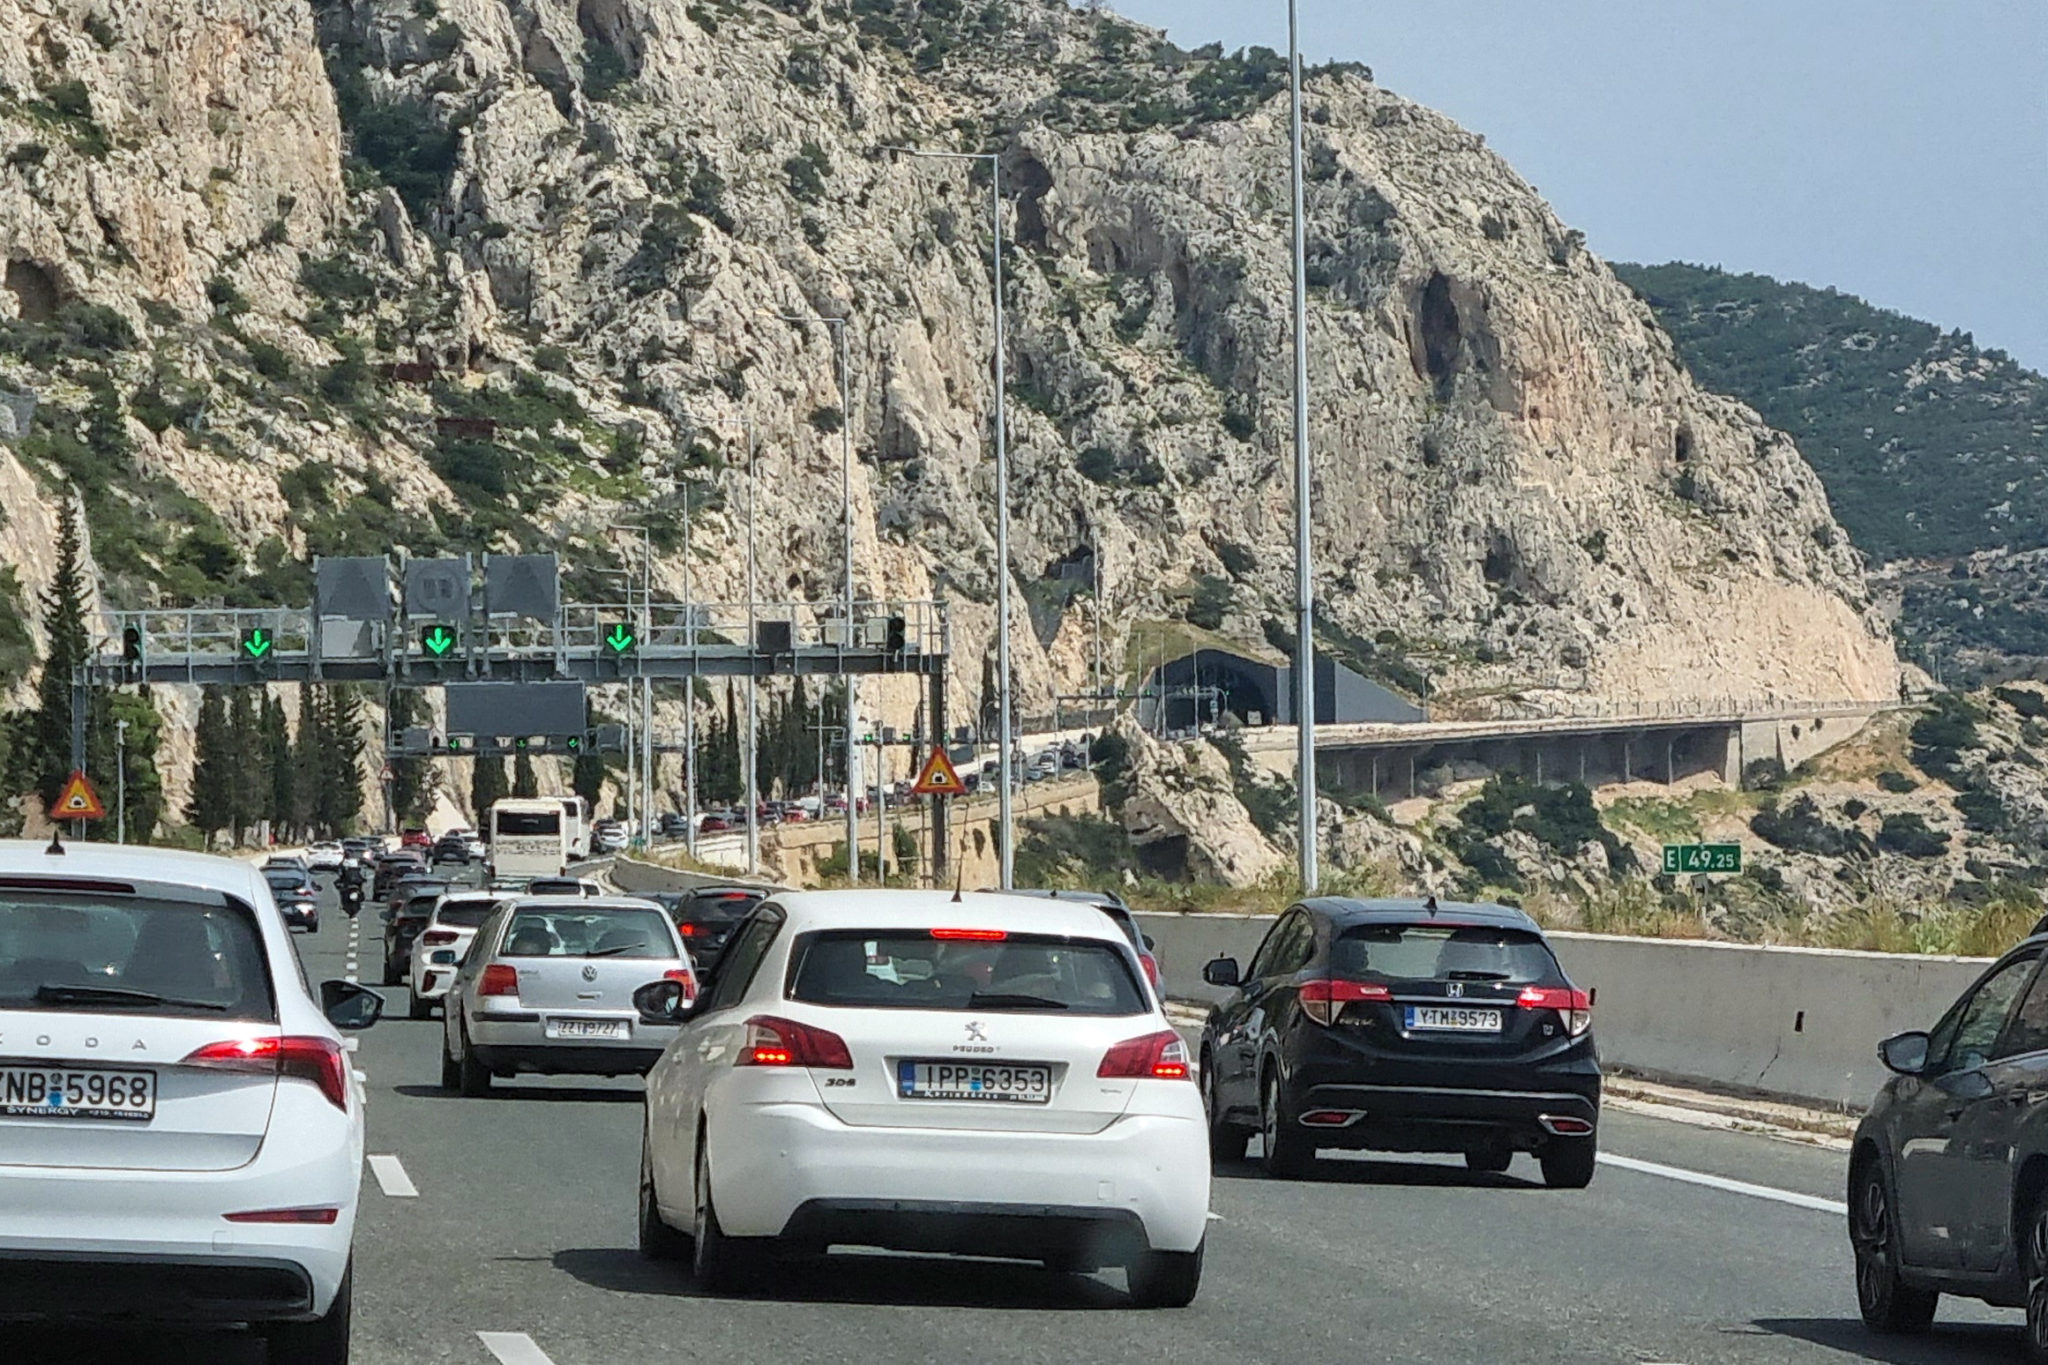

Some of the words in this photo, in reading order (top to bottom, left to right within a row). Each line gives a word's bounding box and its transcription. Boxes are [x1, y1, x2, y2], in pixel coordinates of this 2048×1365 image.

[1667, 850, 1676, 868] E
[1688, 850, 1735, 868] 49.25
[0, 1033, 147, 1050] ODA
[6, 1105, 80, 1116] SYNERGY
